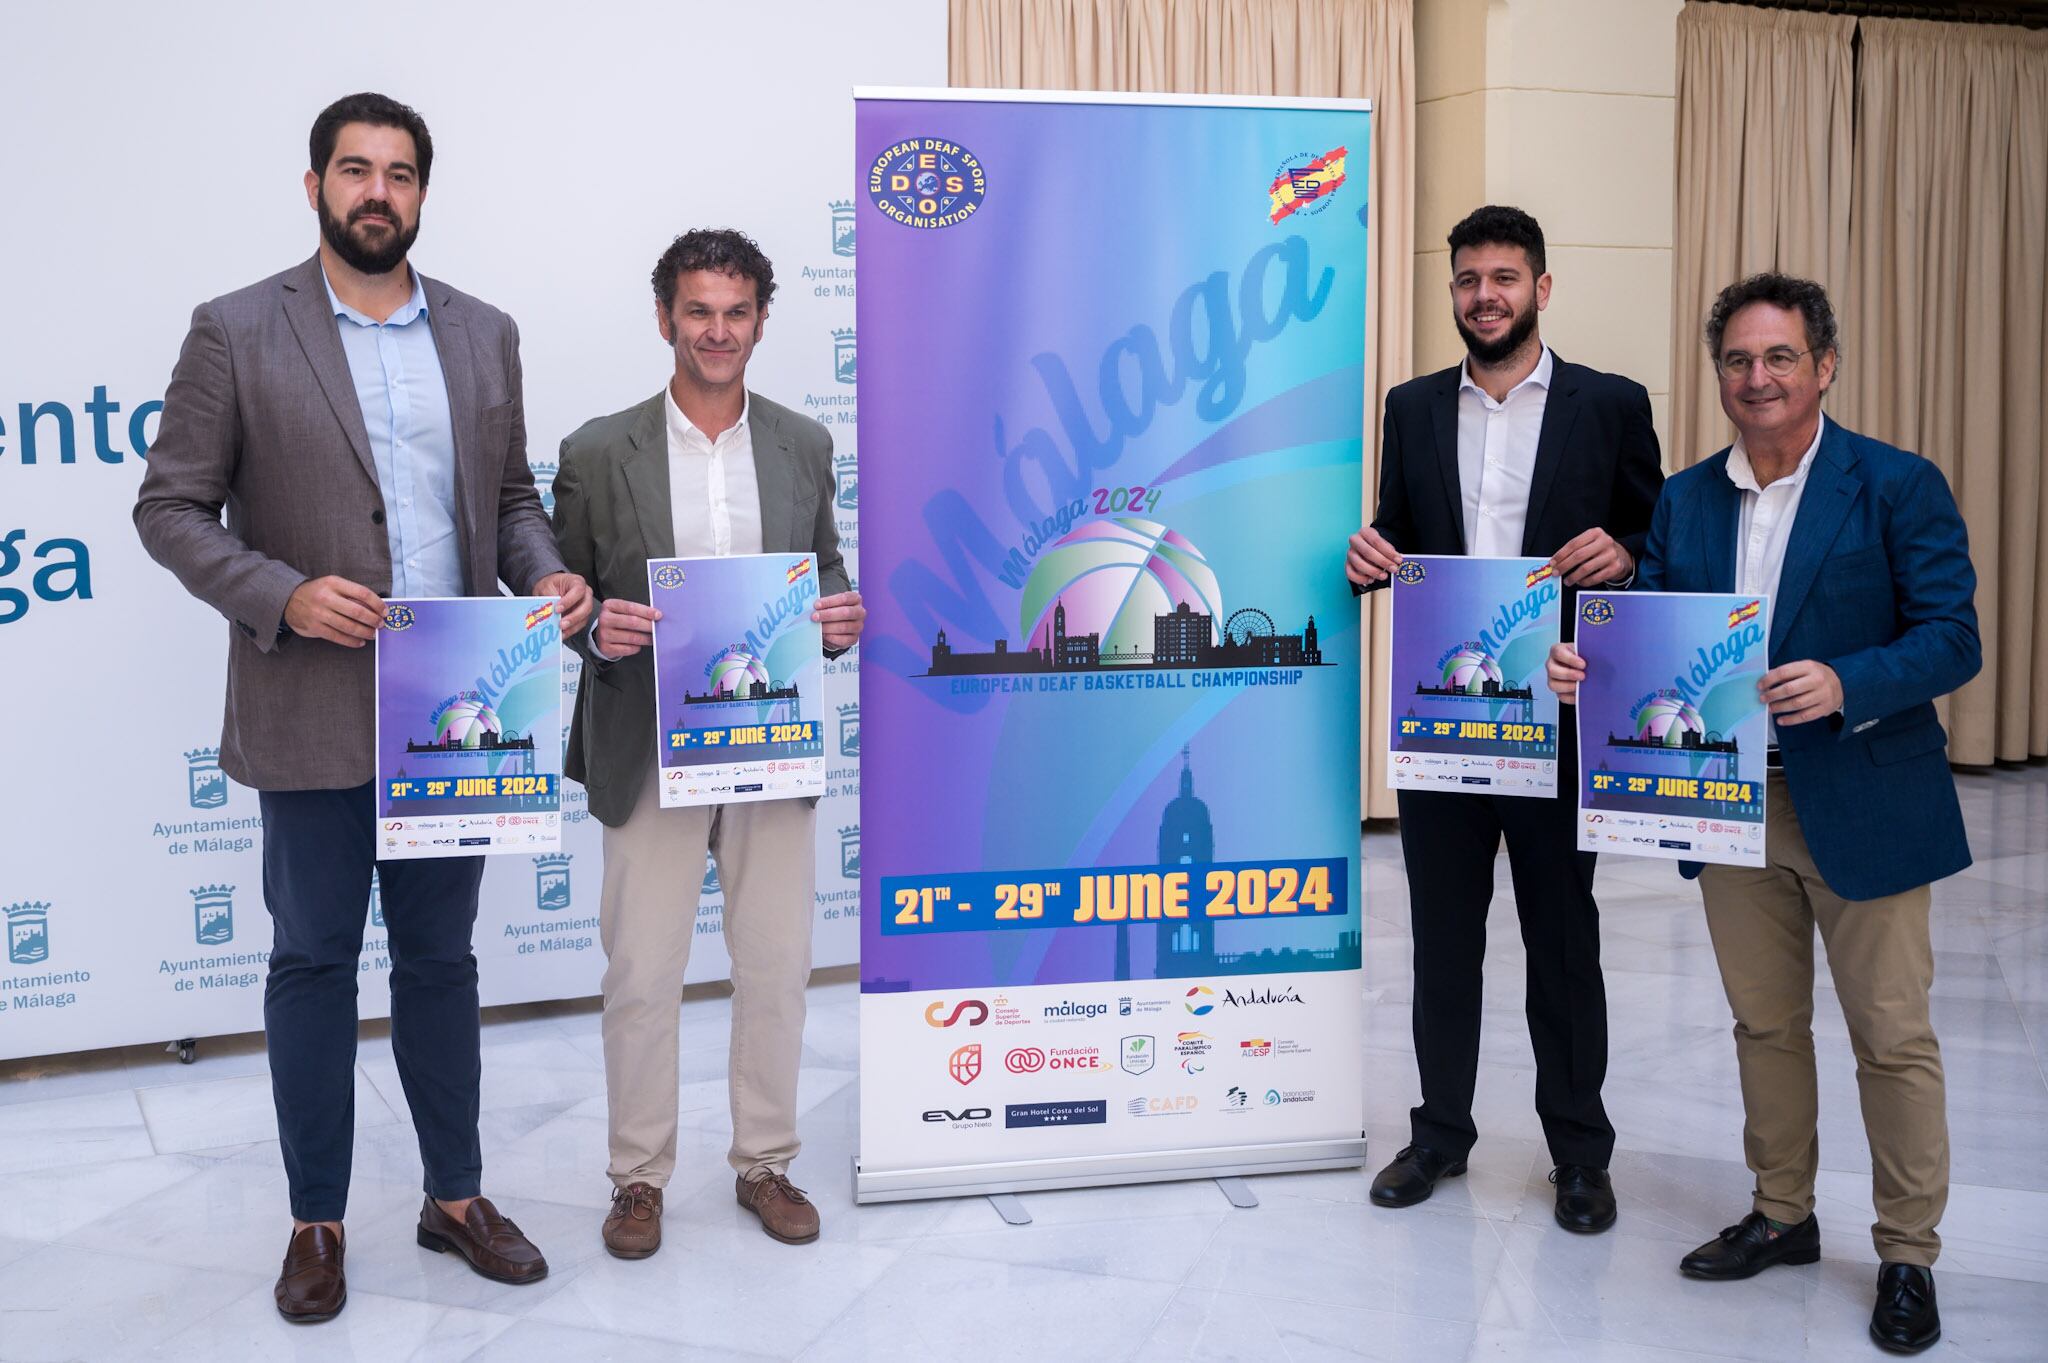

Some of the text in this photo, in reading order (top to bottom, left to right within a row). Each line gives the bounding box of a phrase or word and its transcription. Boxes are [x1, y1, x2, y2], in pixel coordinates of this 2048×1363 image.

[870, 139, 985, 196] EUROPEAN DEAF SPORT
[919, 154, 936, 169] E
[891, 175, 964, 193] D S
[878, 199, 977, 228] ORGANISATION
[918, 198, 937, 215] O
[814, 285, 831, 297] de
[817, 412, 833, 424] de
[867, 234, 1336, 714] Málaga
[999, 486, 1161, 590] Málaga 2024
[745, 578, 817, 660] Málaga
[1478, 583, 1558, 659] Málaga
[475, 623, 560, 709] Málaga
[1674, 622, 1764, 707] Málaga
[951, 670, 1304, 695] EUROPEAN DEAF BASKETBALL CHAMPIONSHIP
[728, 726, 766, 745] JUNE
[771, 724, 812, 743] 2024
[1458, 722, 1497, 739] JUNE
[1501, 724, 1545, 742] 2024
[454, 778, 496, 797] JUNE
[501, 777, 548, 795] 2024
[1656, 777, 1698, 798] JUNE
[1703, 781, 1751, 802] 2024
[168, 837, 253, 855] de Málaga
[1073, 872, 1190, 923] JUNE
[1205, 866, 1334, 917] 2024
[824, 908, 840, 920] de
[517, 937, 593, 954] de Málaga
[159, 952, 271, 975] Ayuntamiento
[0, 970, 90, 990] ntamiento
[174, 973, 258, 992] de Málaga
[13, 992, 76, 1009] Málaga
[1004, 1018, 1031, 1026] Deportes
[1050, 1047, 1099, 1056] Fundación
[1242, 1048, 1270, 1057] ADESP
[1050, 1057, 1099, 1070] ONCE
[1011, 1110, 1028, 1118] Gran
[1030, 1108, 1050, 1116] Hotel
[1051, 1107, 1072, 1115] Costa
